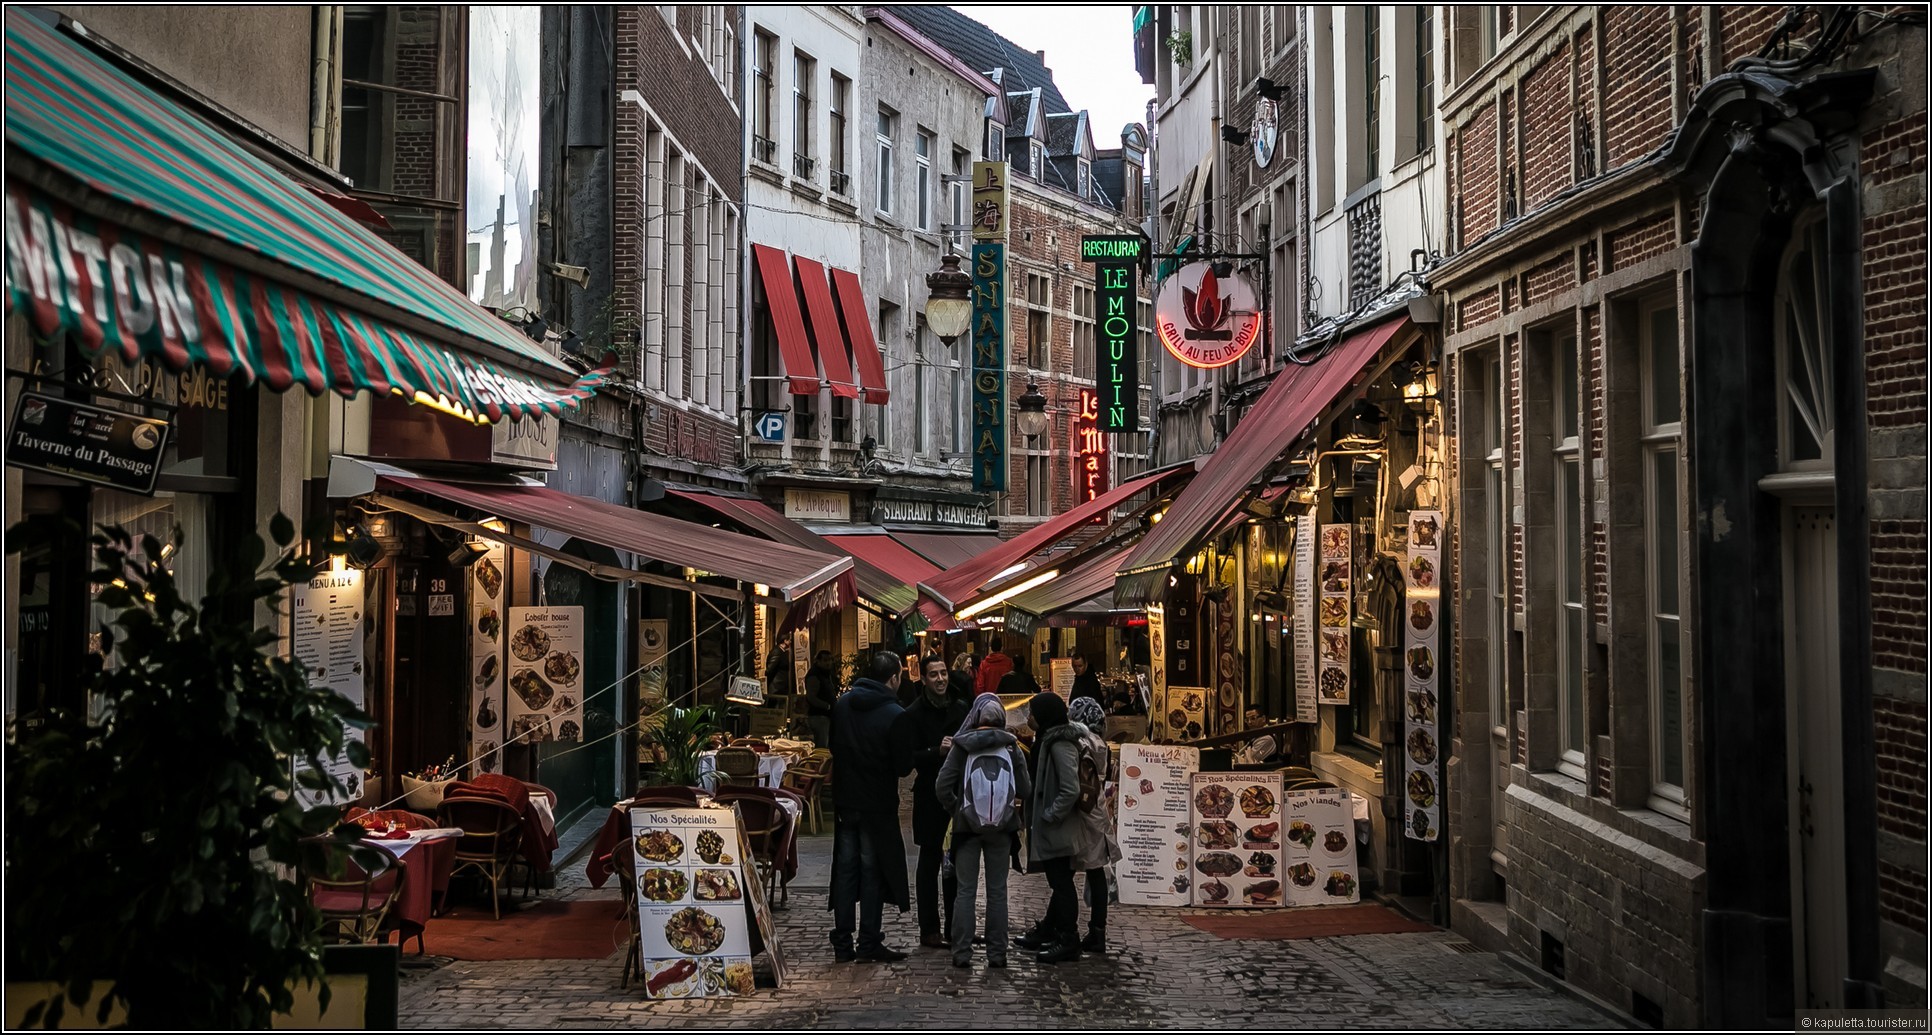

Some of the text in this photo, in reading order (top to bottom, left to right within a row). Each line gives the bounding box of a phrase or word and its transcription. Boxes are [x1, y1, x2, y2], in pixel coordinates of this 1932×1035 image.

[974, 167, 1003, 232] 上海
[1104, 268, 1129, 428] LE MOULIN
[1163, 322, 1254, 361] GRILL AU FEU DE BOIS
[975, 252, 1001, 487] SHANGHAI
[508, 413, 548, 447] HOUSE
[766, 418, 783, 439] P
[17, 430, 72, 457] Taverne
[75, 444, 94, 462] du
[97, 450, 152, 476] Passage
[308, 578, 329, 590] MENU
[330, 578, 335, 588] A
[337, 577, 346, 587] 12
[431, 579, 446, 593] 39
[524, 612, 549, 622] Lobster
[741, 682, 760, 692] FREE
[1137, 748, 1160, 759] Menu
[1292, 797, 1341, 811] Nos Viandes
[650, 814, 717, 826] Nos Spécialités
